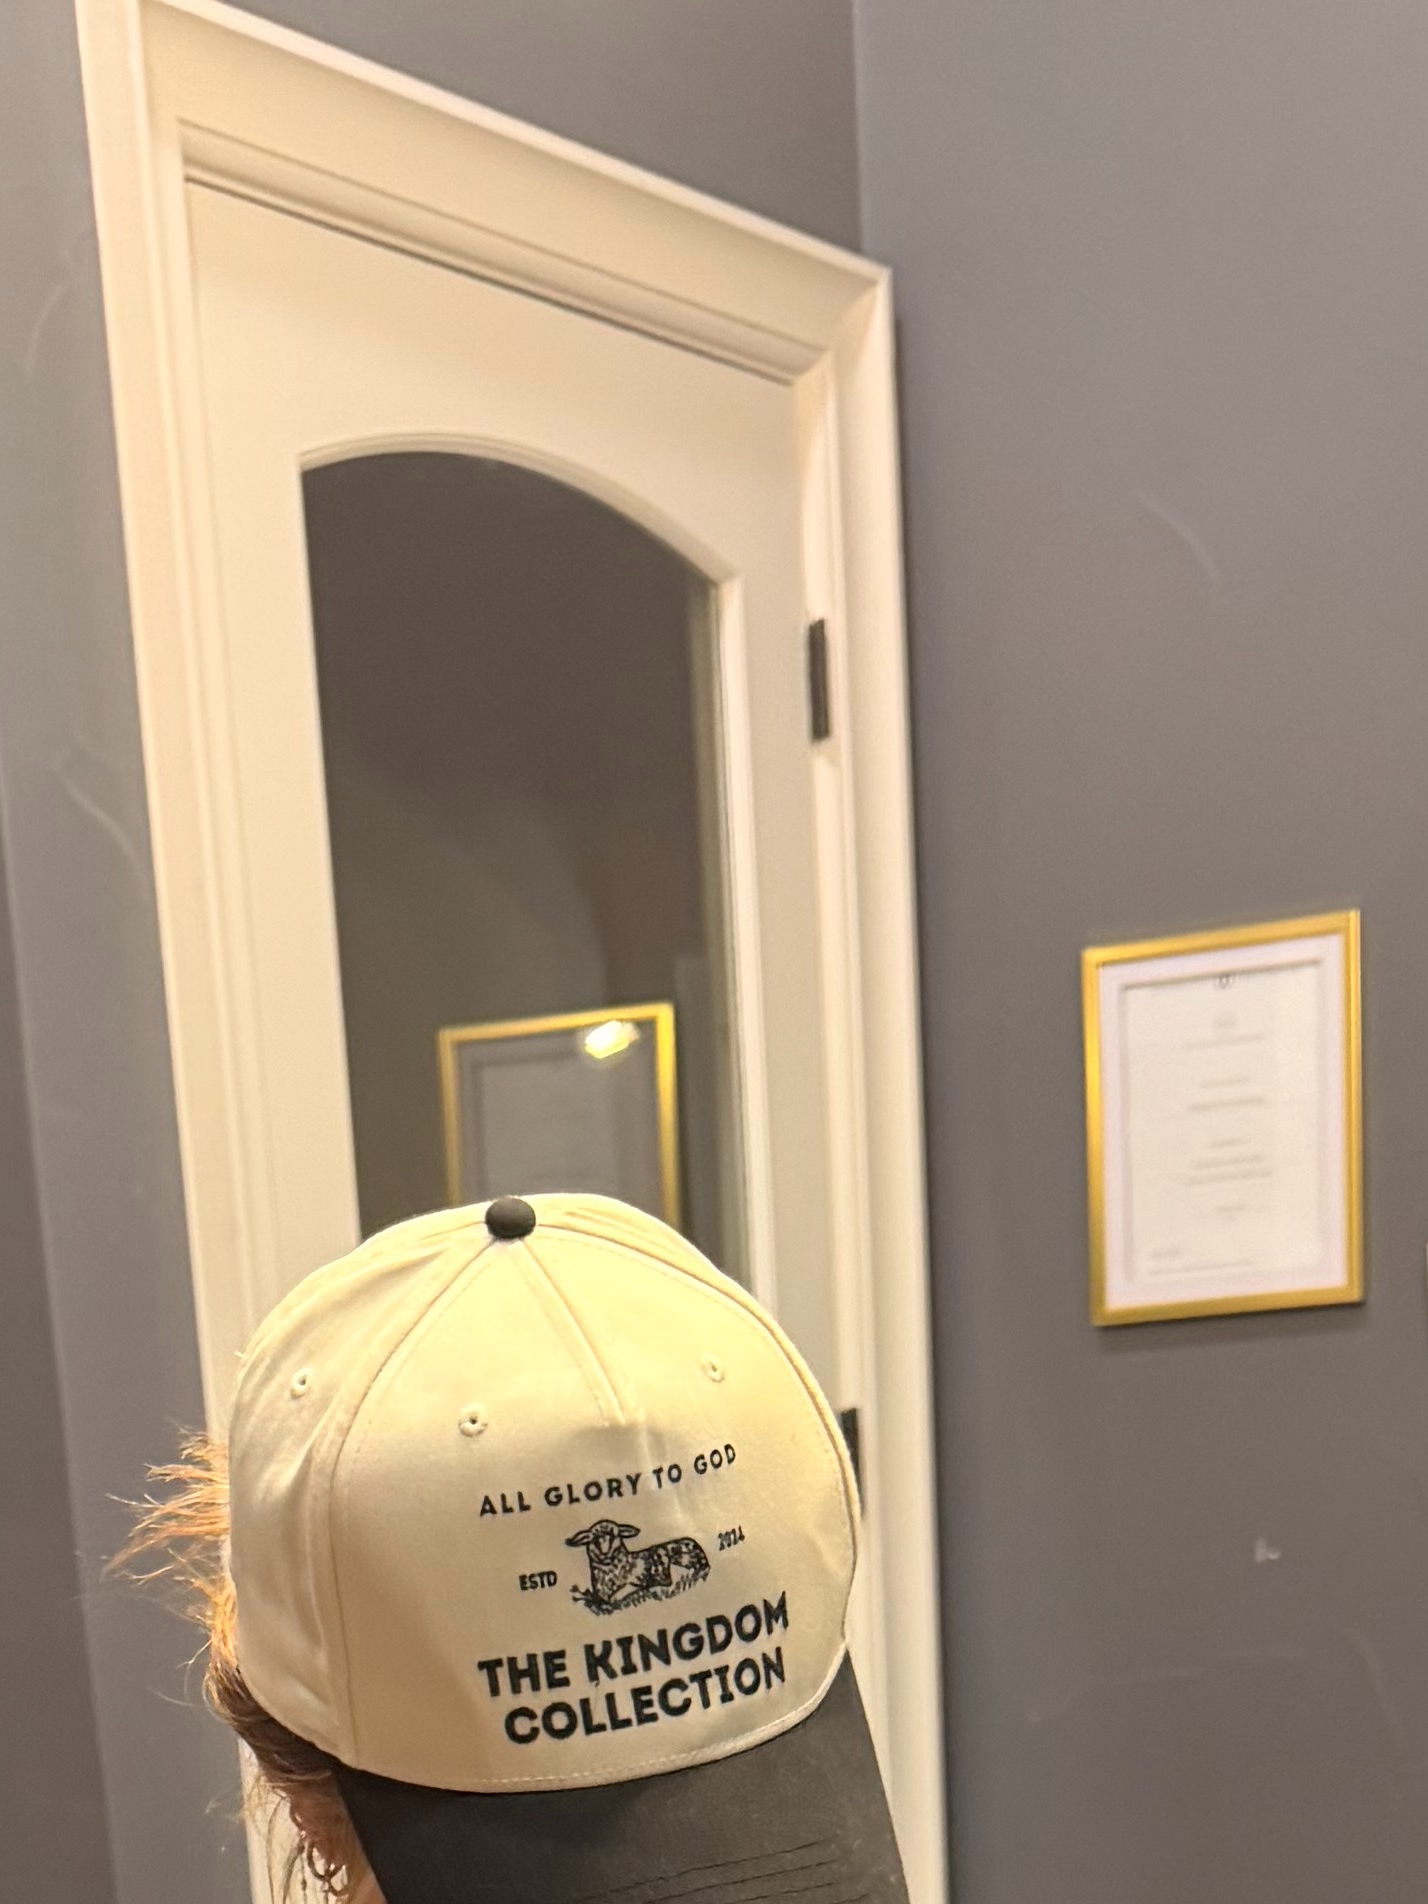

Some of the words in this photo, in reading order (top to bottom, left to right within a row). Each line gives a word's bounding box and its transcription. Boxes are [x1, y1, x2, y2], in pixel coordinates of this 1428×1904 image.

[478, 1490, 532, 1518] ALL
[543, 1472, 642, 1508] GLORY
[651, 1462, 683, 1490] TO
[693, 1443, 737, 1476] GOD
[518, 1569, 558, 1592] ESTD
[476, 1648, 571, 1698] THE
[583, 1589, 789, 1684] KINGDOM
[504, 1646, 786, 1745] COLLECTION
